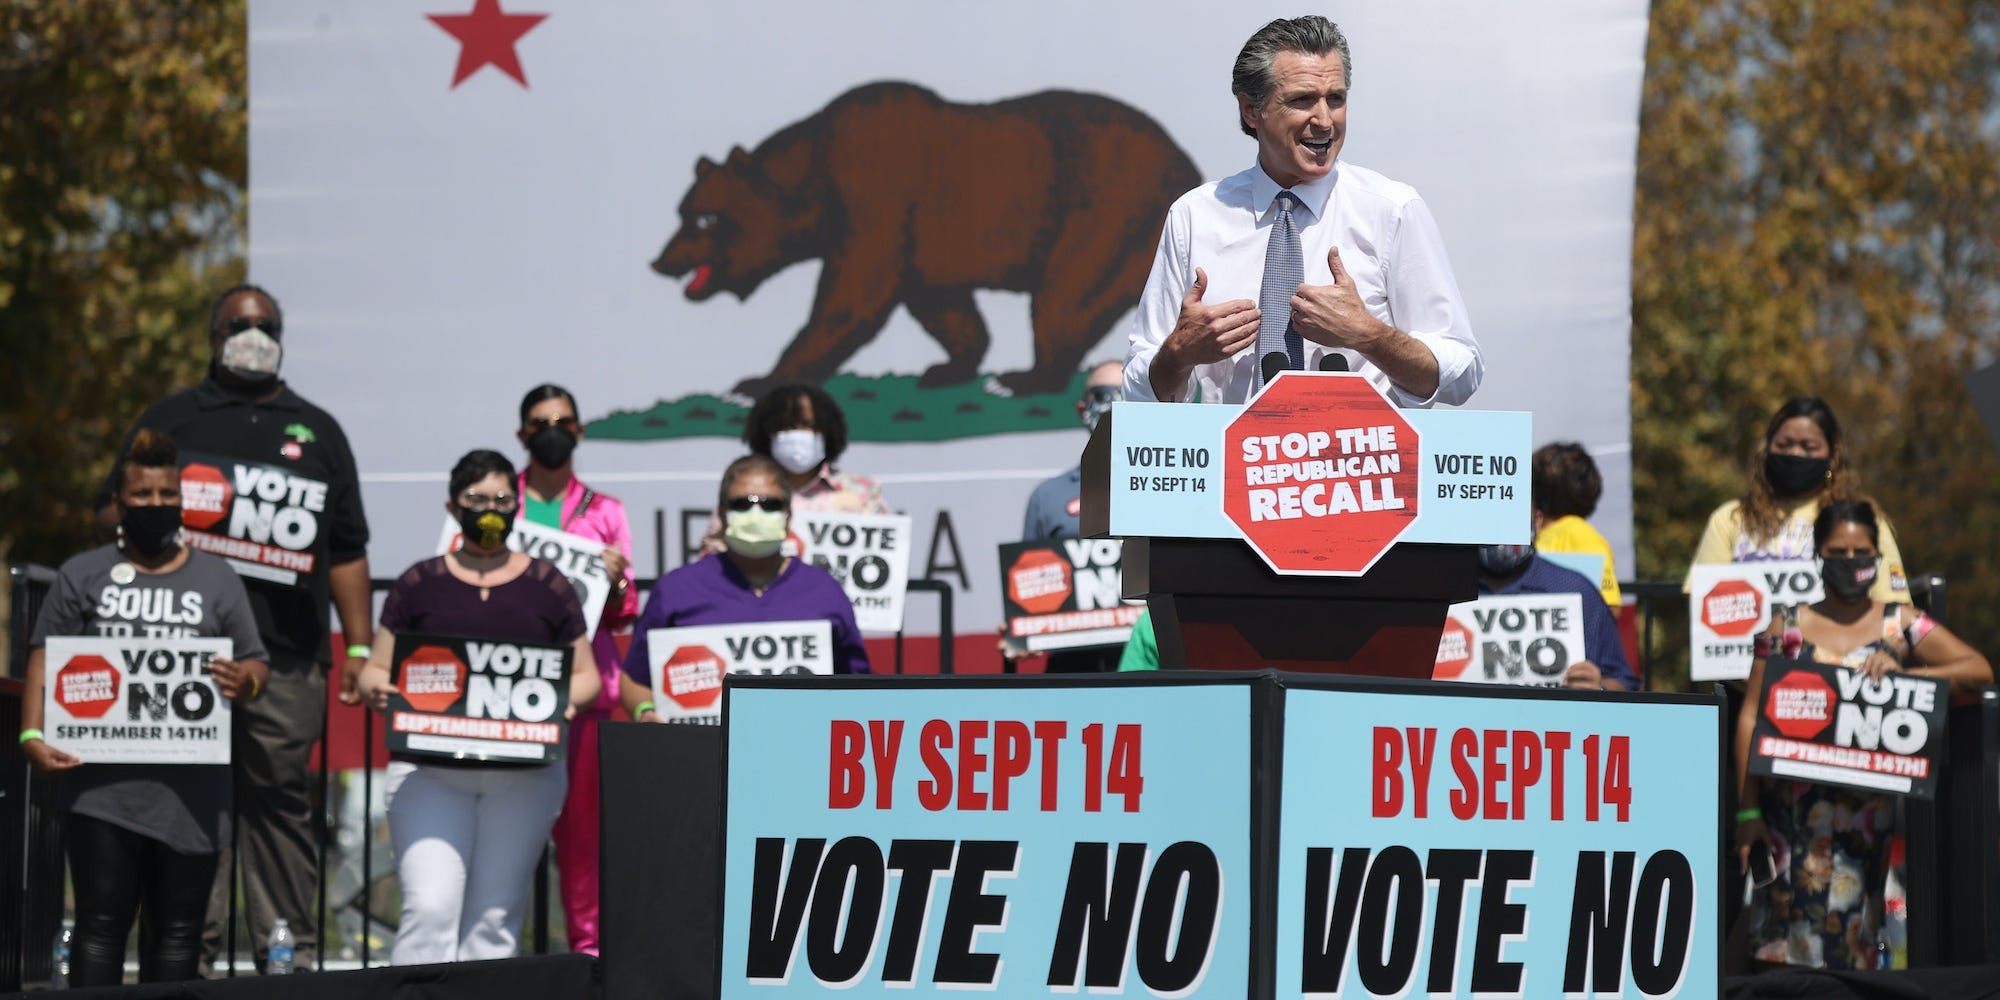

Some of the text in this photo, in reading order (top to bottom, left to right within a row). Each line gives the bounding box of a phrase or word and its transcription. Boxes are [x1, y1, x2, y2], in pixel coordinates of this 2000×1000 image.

[1127, 446, 1210, 469] VOTE NO
[1241, 425, 1397, 463] STOP THE
[1246, 453, 1401, 486] REPUBLICAN
[1434, 454, 1517, 477] VOTE NO
[234, 464, 329, 513] VOTE
[1129, 477, 1206, 493] BY SEPT 14
[1248, 477, 1406, 522] RECALL
[1437, 484, 1514, 501] BY SEPT 14
[228, 496, 318, 551] NO
[808, 522, 897, 551] VOTE
[263, 548, 314, 573] 14TH!
[518, 532, 607, 578] VOTE
[1063, 539, 1122, 569] VO
[1764, 572, 1815, 595] VO
[96, 584, 203, 625] SOULS
[851, 597, 891, 609] 4TH!
[1473, 608, 1569, 633] VOTE
[121, 649, 218, 676] VOTE
[466, 641, 564, 680] VOTE
[726, 635, 818, 662] VOTE
[1482, 637, 1568, 680] NO
[64, 687, 114, 704] RECALL
[128, 681, 215, 721] NO
[466, 674, 558, 722] NO
[1836, 668, 1937, 713] VOTE
[57, 725, 217, 740] SEPTEMBER 14TH!
[395, 713, 558, 742] SEPTEMBER 14TH!
[1834, 701, 1929, 755] NO
[828, 718, 1144, 813] BY SEPT 14
[1372, 726, 1632, 823] BY SEPT 14
[1762, 740, 1870, 770] SEPTEMBER
[1874, 754, 1927, 777] 14TH!
[746, 835, 1222, 996] VOTE NO
[1301, 845, 1696, 999] VOTE NO
